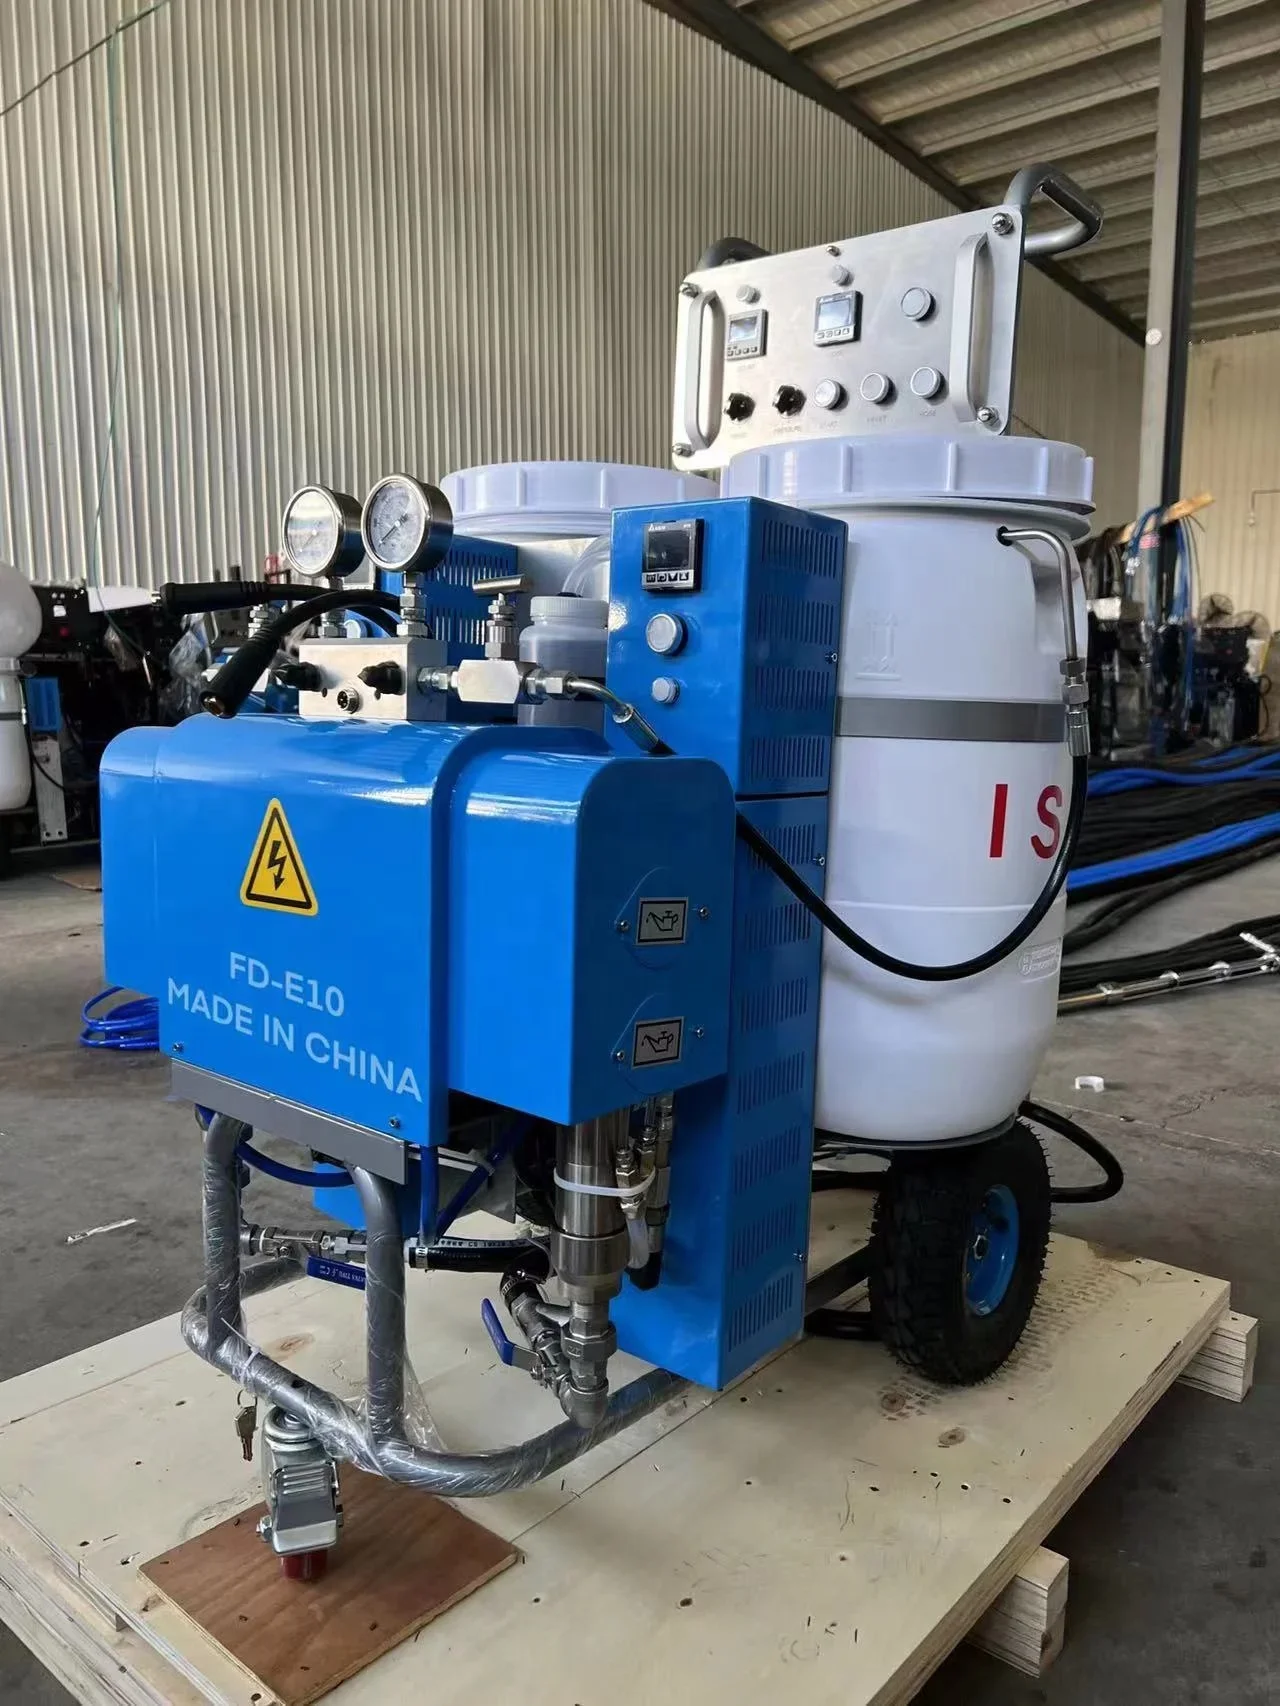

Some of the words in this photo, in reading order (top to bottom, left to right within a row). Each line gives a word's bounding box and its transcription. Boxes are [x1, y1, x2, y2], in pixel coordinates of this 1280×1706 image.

[229, 951, 345, 1017] FD-E10
[167, 977, 253, 1036] MADE
[263, 1013, 294, 1053] IN
[305, 1032, 423, 1103] CHINA
